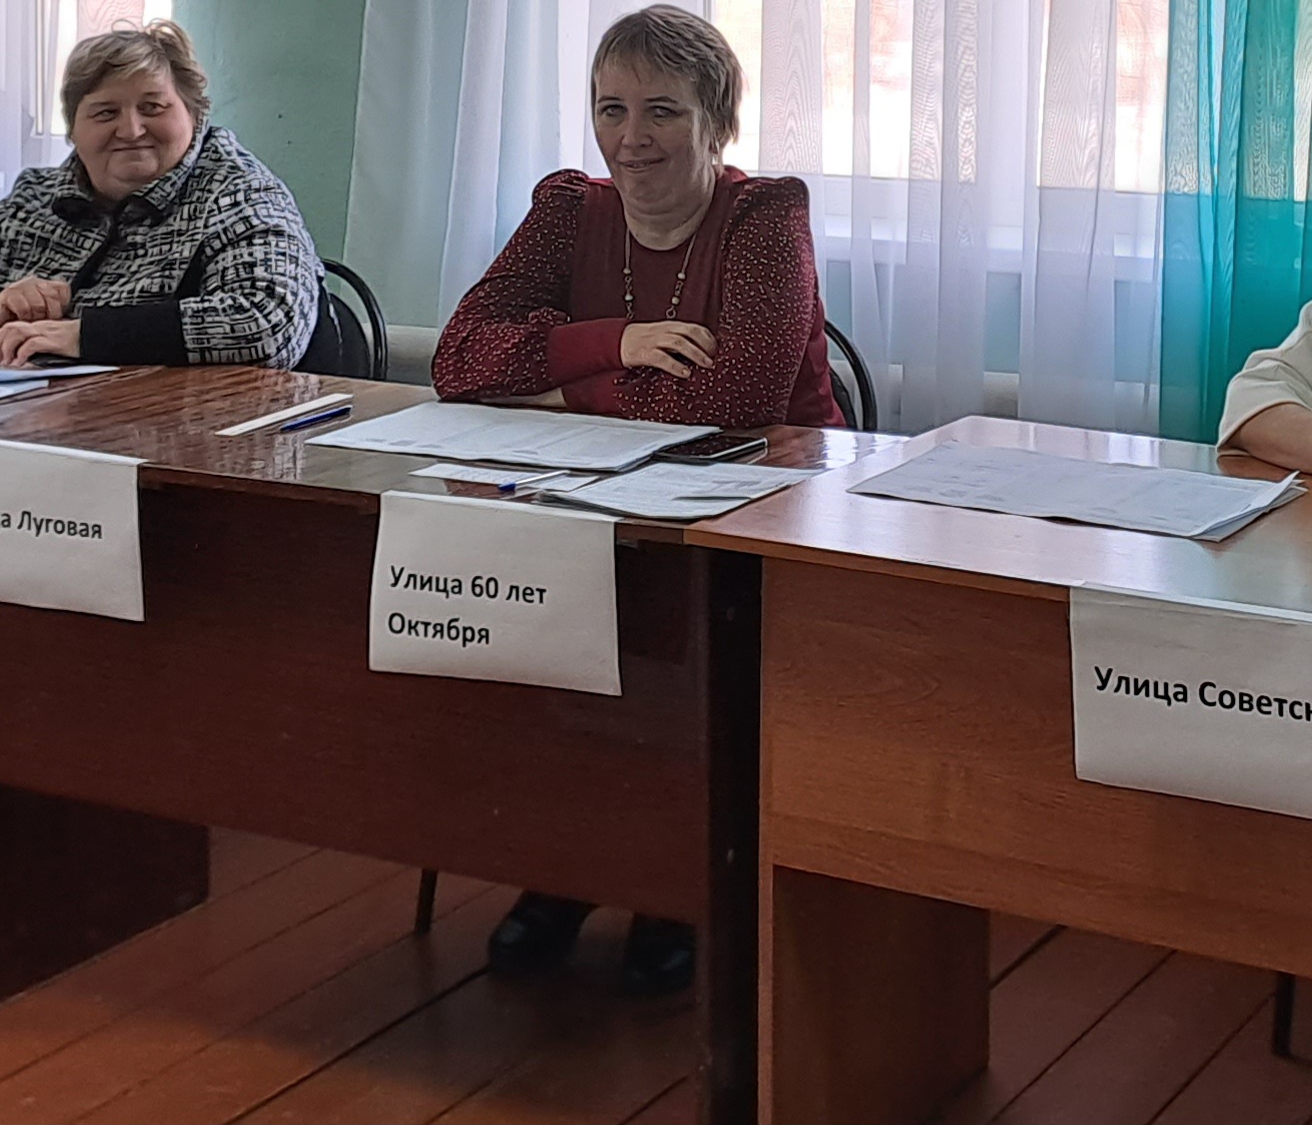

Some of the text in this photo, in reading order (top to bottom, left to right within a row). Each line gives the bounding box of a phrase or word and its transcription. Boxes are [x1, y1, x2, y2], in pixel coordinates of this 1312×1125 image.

[17, 510, 103, 539] Луговая
[389, 565, 547, 604] Улица 60 лет
[387, 612, 490, 648] Октября
[1093, 665, 1188, 707] Улица
